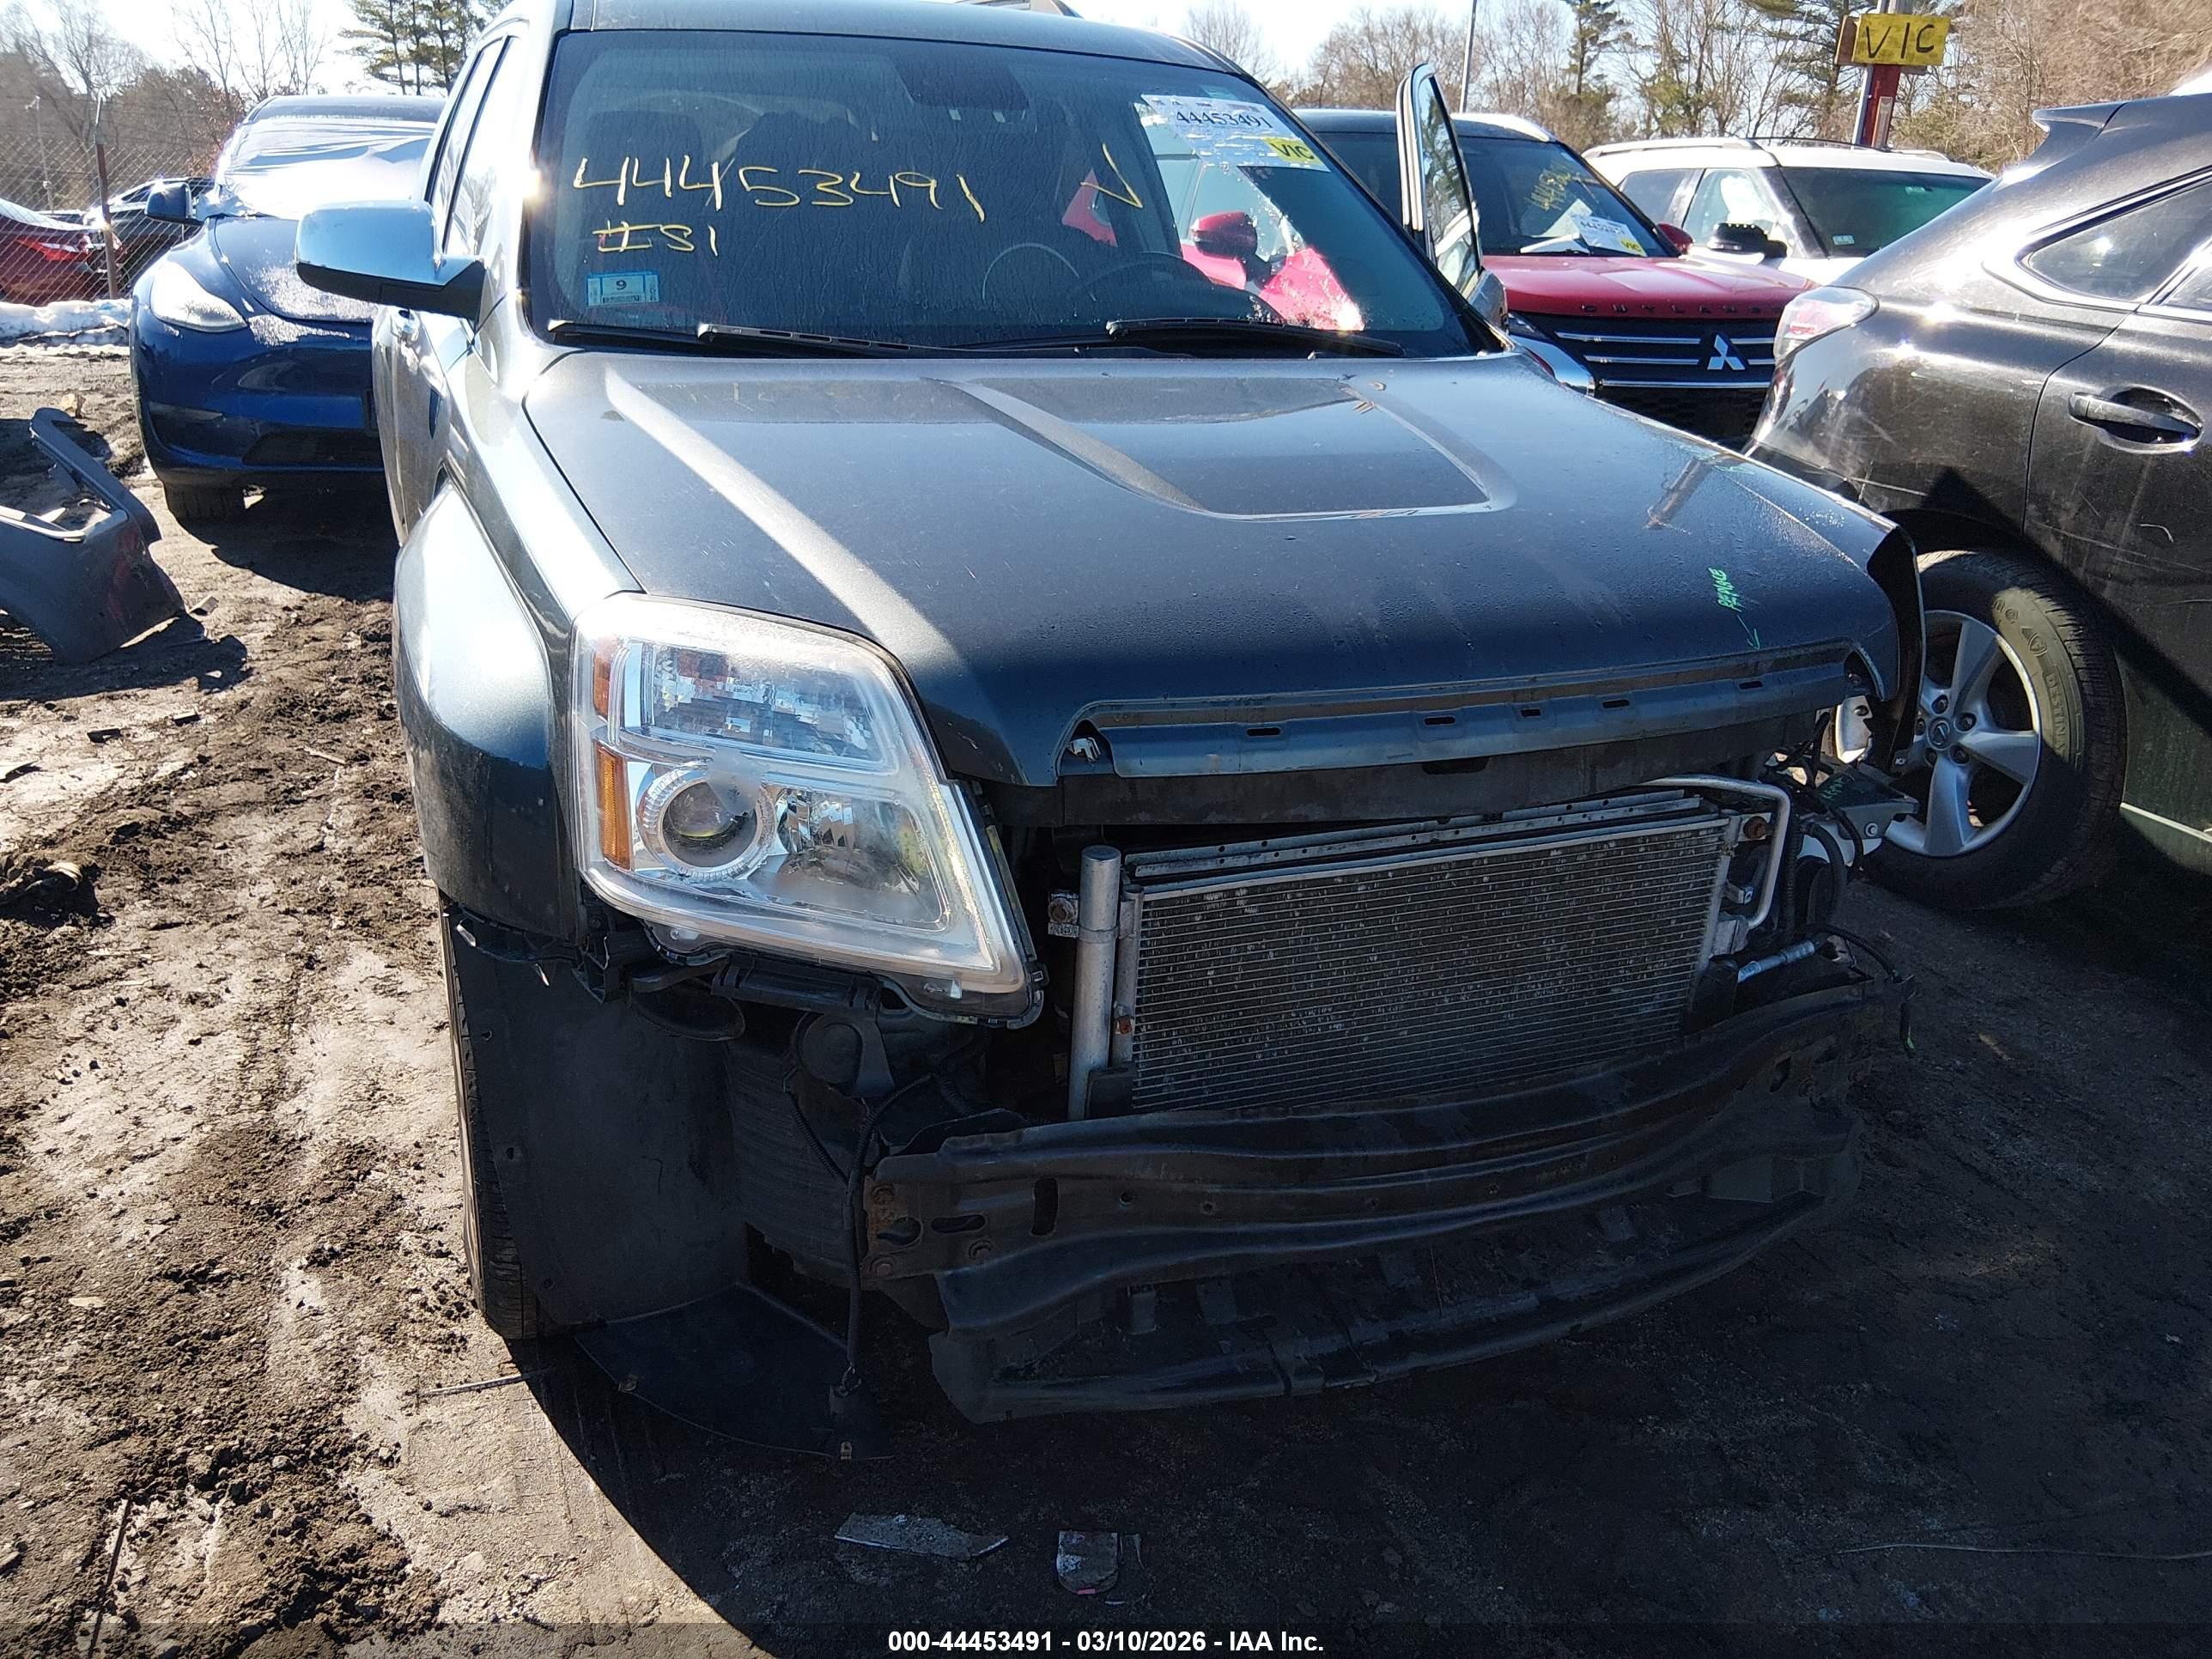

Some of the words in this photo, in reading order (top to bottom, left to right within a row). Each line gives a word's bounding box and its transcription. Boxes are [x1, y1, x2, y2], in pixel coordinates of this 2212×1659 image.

[1865, 22, 1936, 59] VIC
[1176, 111, 1273, 128] 44453491
[1270, 143, 1316, 161] VIC
[574, 155, 986, 223] 44453491
[616, 279, 628, 291] 9
